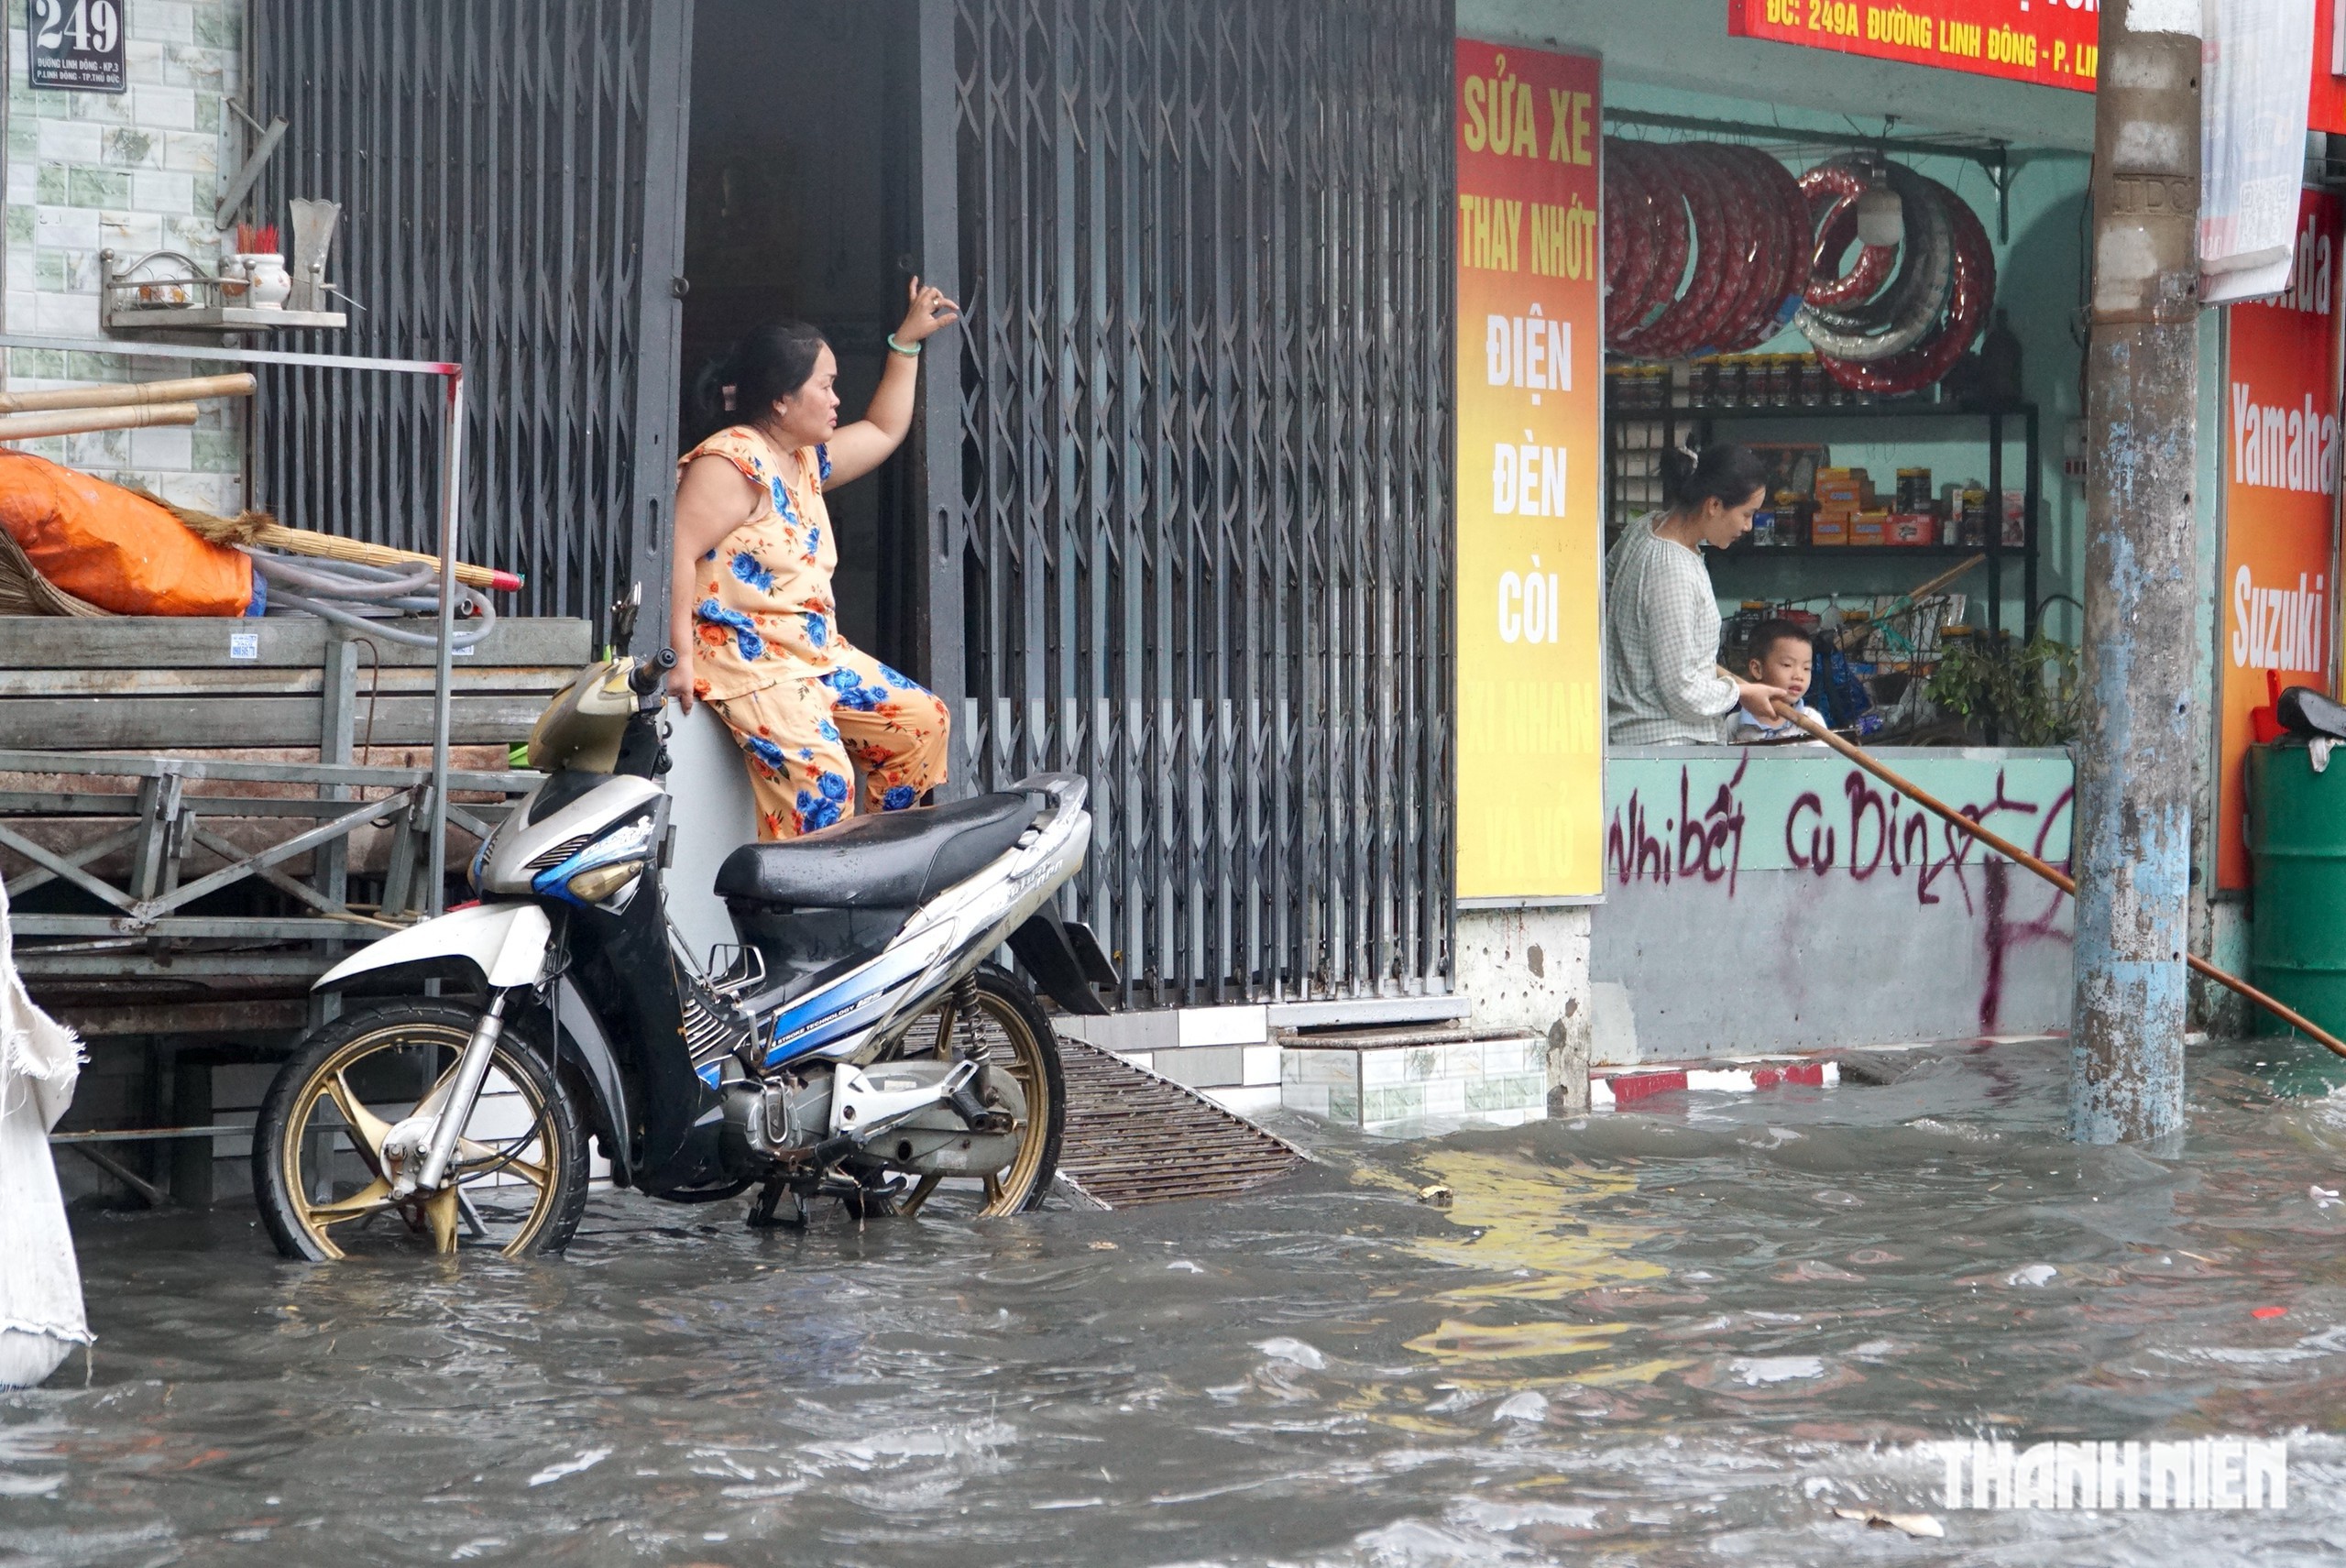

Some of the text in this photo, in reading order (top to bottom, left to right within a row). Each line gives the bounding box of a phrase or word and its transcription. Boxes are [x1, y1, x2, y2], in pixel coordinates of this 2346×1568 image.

[36, 0, 117, 52] 249
[61, 59, 78, 70] LINH
[79, 58, 98, 71] ĐÔNG
[103, 61, 119, 72] KP.3
[1807, 0, 1859, 38] 249A
[1867, 4, 1932, 49] ĐƯỜNG
[1939, 19, 1980, 58] LINH
[1988, 22, 2036, 67] ĐÔNG
[2053, 38, 2070, 73] P.
[37, 71, 58, 80] P.LINH
[59, 70, 78, 82] ĐÔNG
[1464, 53, 1593, 166] SỬA XE
[1459, 192, 1597, 281] THAY NHỚT
[1485, 302, 1573, 406] ĐIỆN
[1492, 428, 1567, 518] ĐÈN
[2232, 381, 2336, 495] Yamaha
[1497, 554, 1558, 644] CÒI
[2232, 564, 2324, 673] Suzuki
[777, 1027, 806, 1045] STROKE
[806, 1005, 855, 1031] TECHNOLOGY
